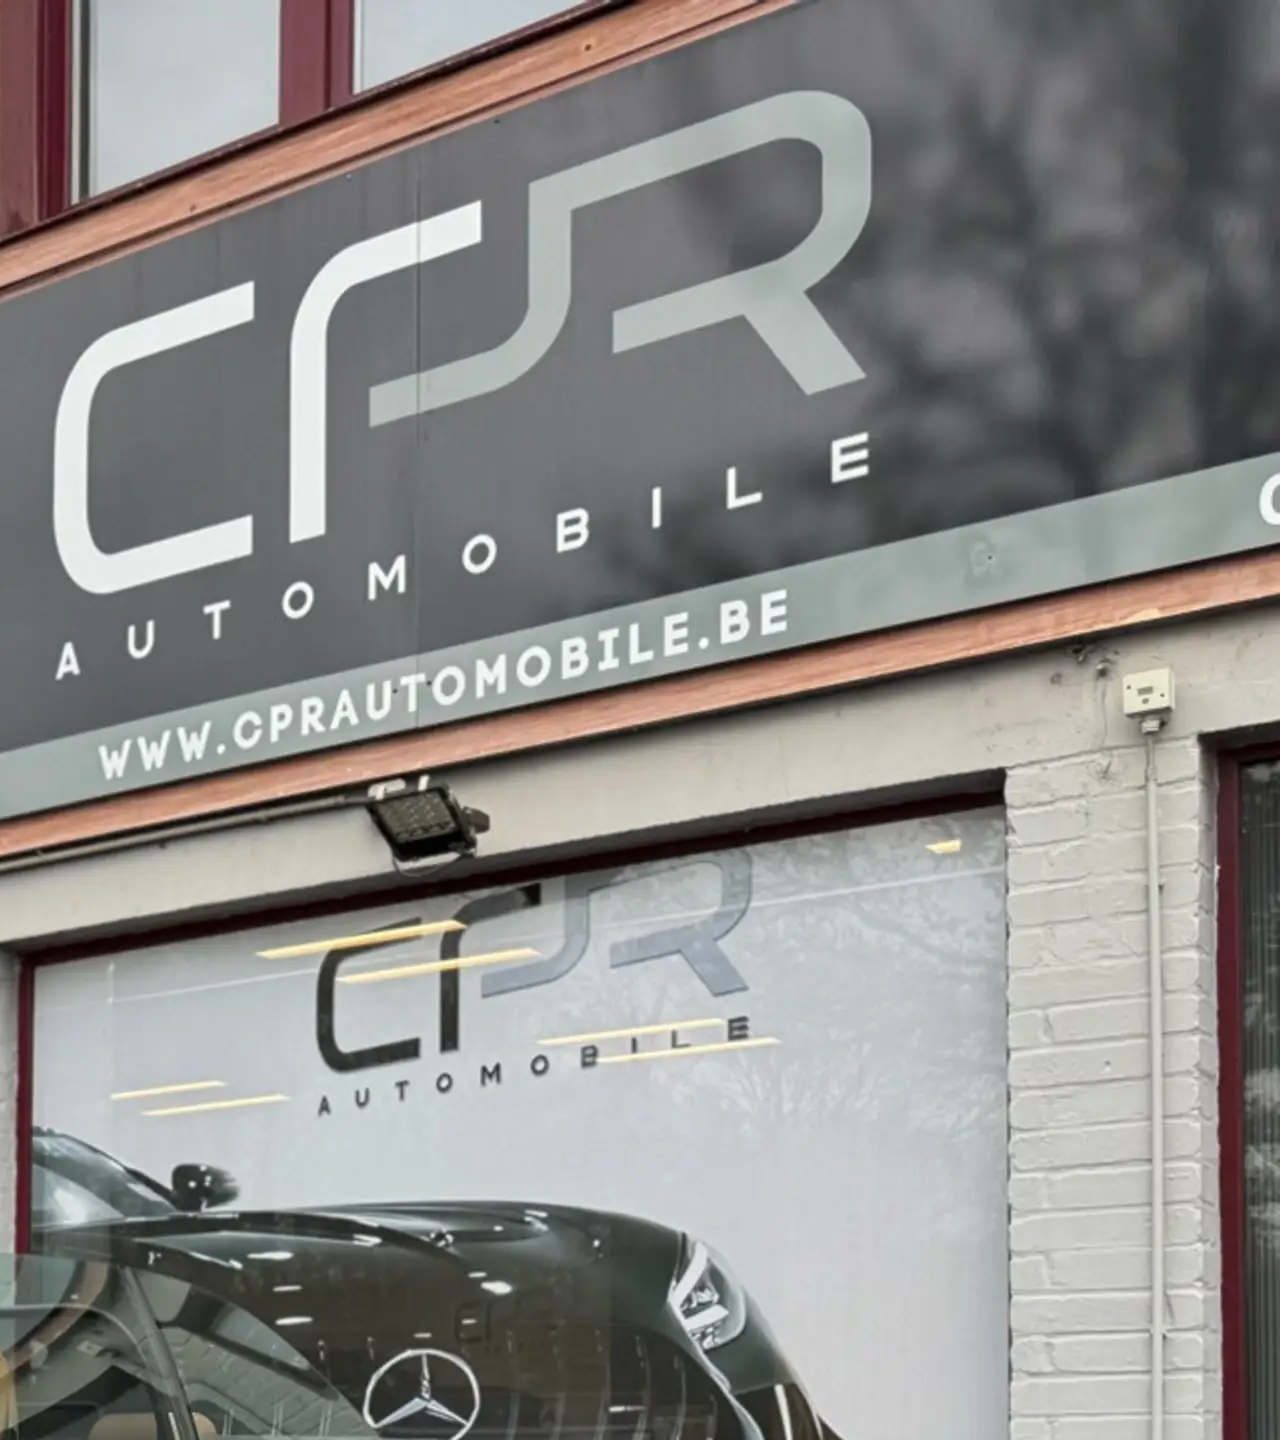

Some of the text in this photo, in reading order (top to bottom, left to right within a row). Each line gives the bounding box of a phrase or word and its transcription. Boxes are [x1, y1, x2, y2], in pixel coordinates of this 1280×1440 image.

[53, 89, 873, 595] CPR
[55, 431, 870, 681] AUTOMOBILE
[99, 590, 788, 781] WWW.CPRAUTOMOBILE.BE
[316, 851, 753, 1073] CPR
[317, 1015, 750, 1116] AUTOMOBILE
